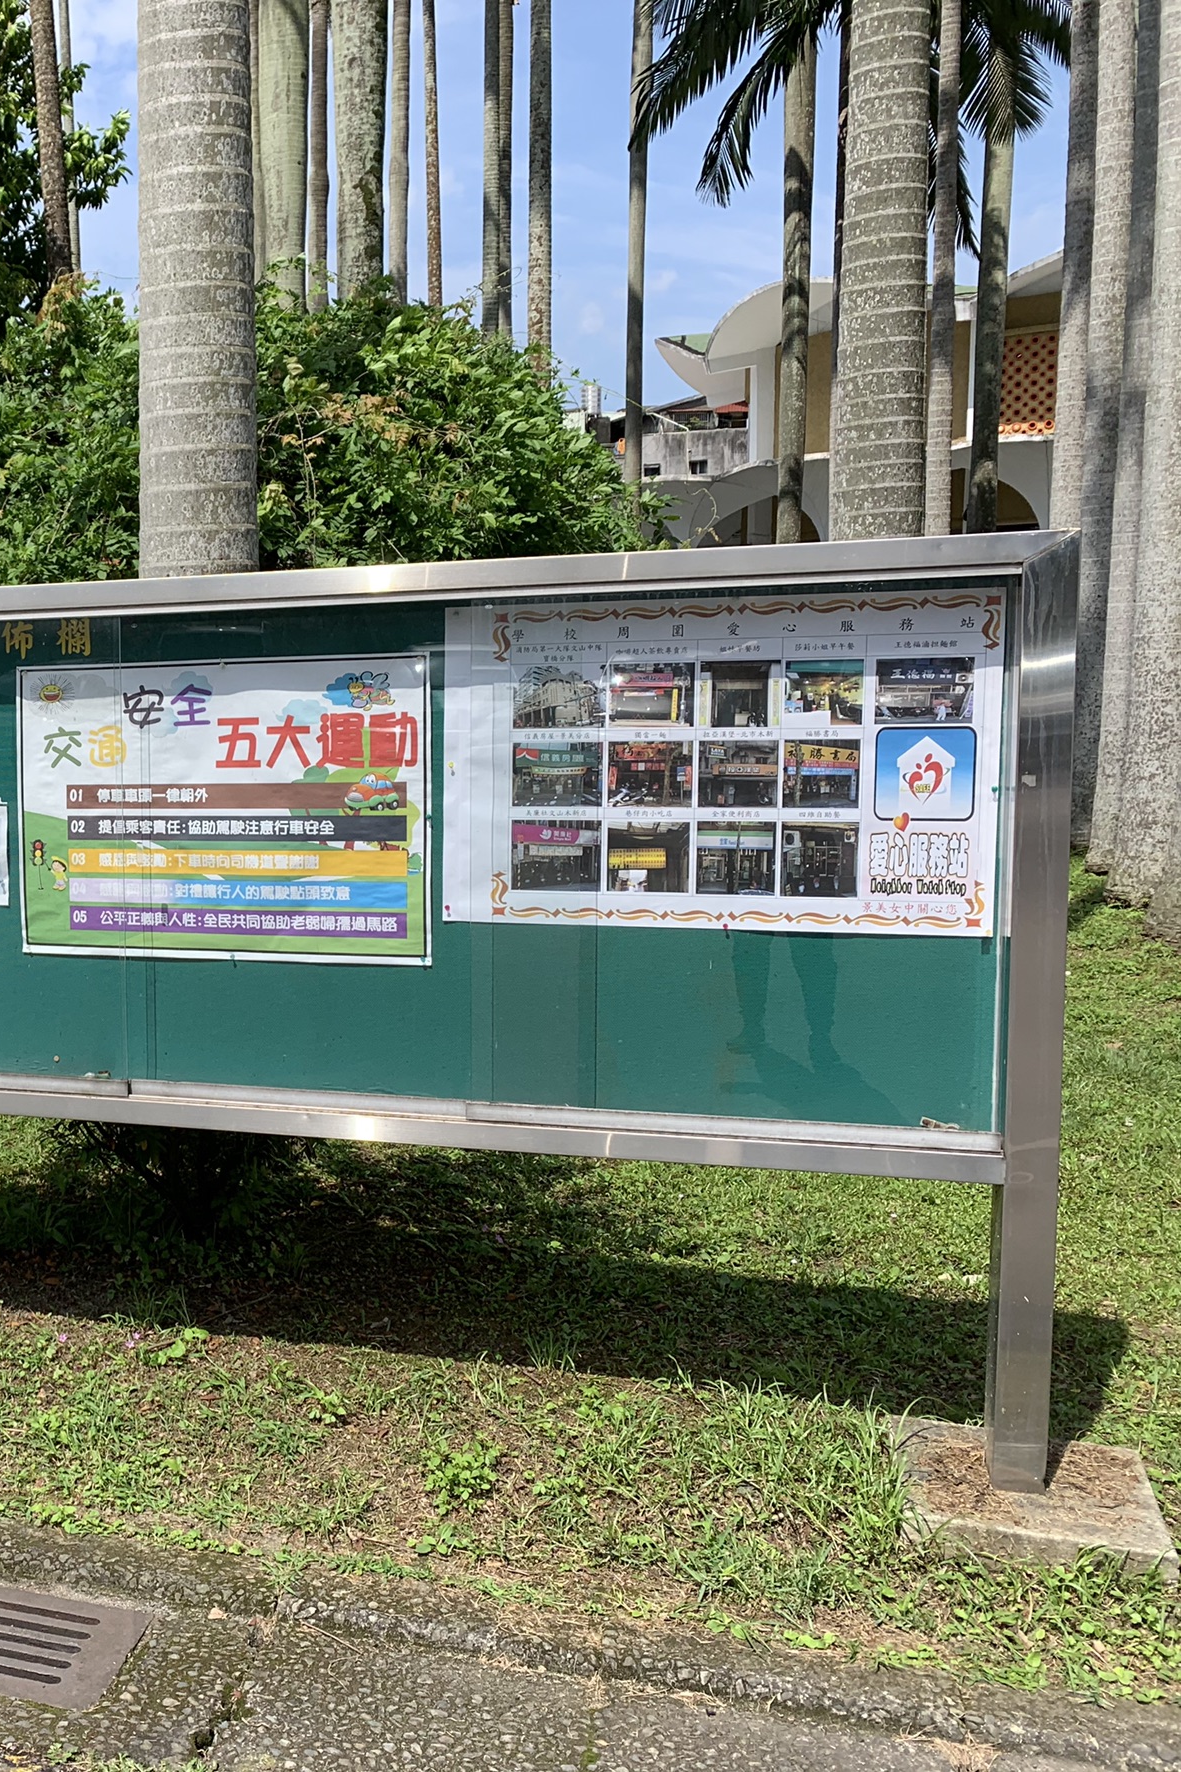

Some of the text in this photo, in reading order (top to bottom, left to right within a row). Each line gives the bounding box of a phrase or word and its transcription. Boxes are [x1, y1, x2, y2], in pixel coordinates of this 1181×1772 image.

[44, 685, 419, 769] 交通 安全 五大運動
[69, 788, 83, 802] 01
[70, 819, 86, 833] 02
[71, 852, 86, 866] 03
[869, 832, 970, 878] 愛心服務站
[862, 902, 958, 914] 景美女中關心您
[72, 910, 88, 924] 05
